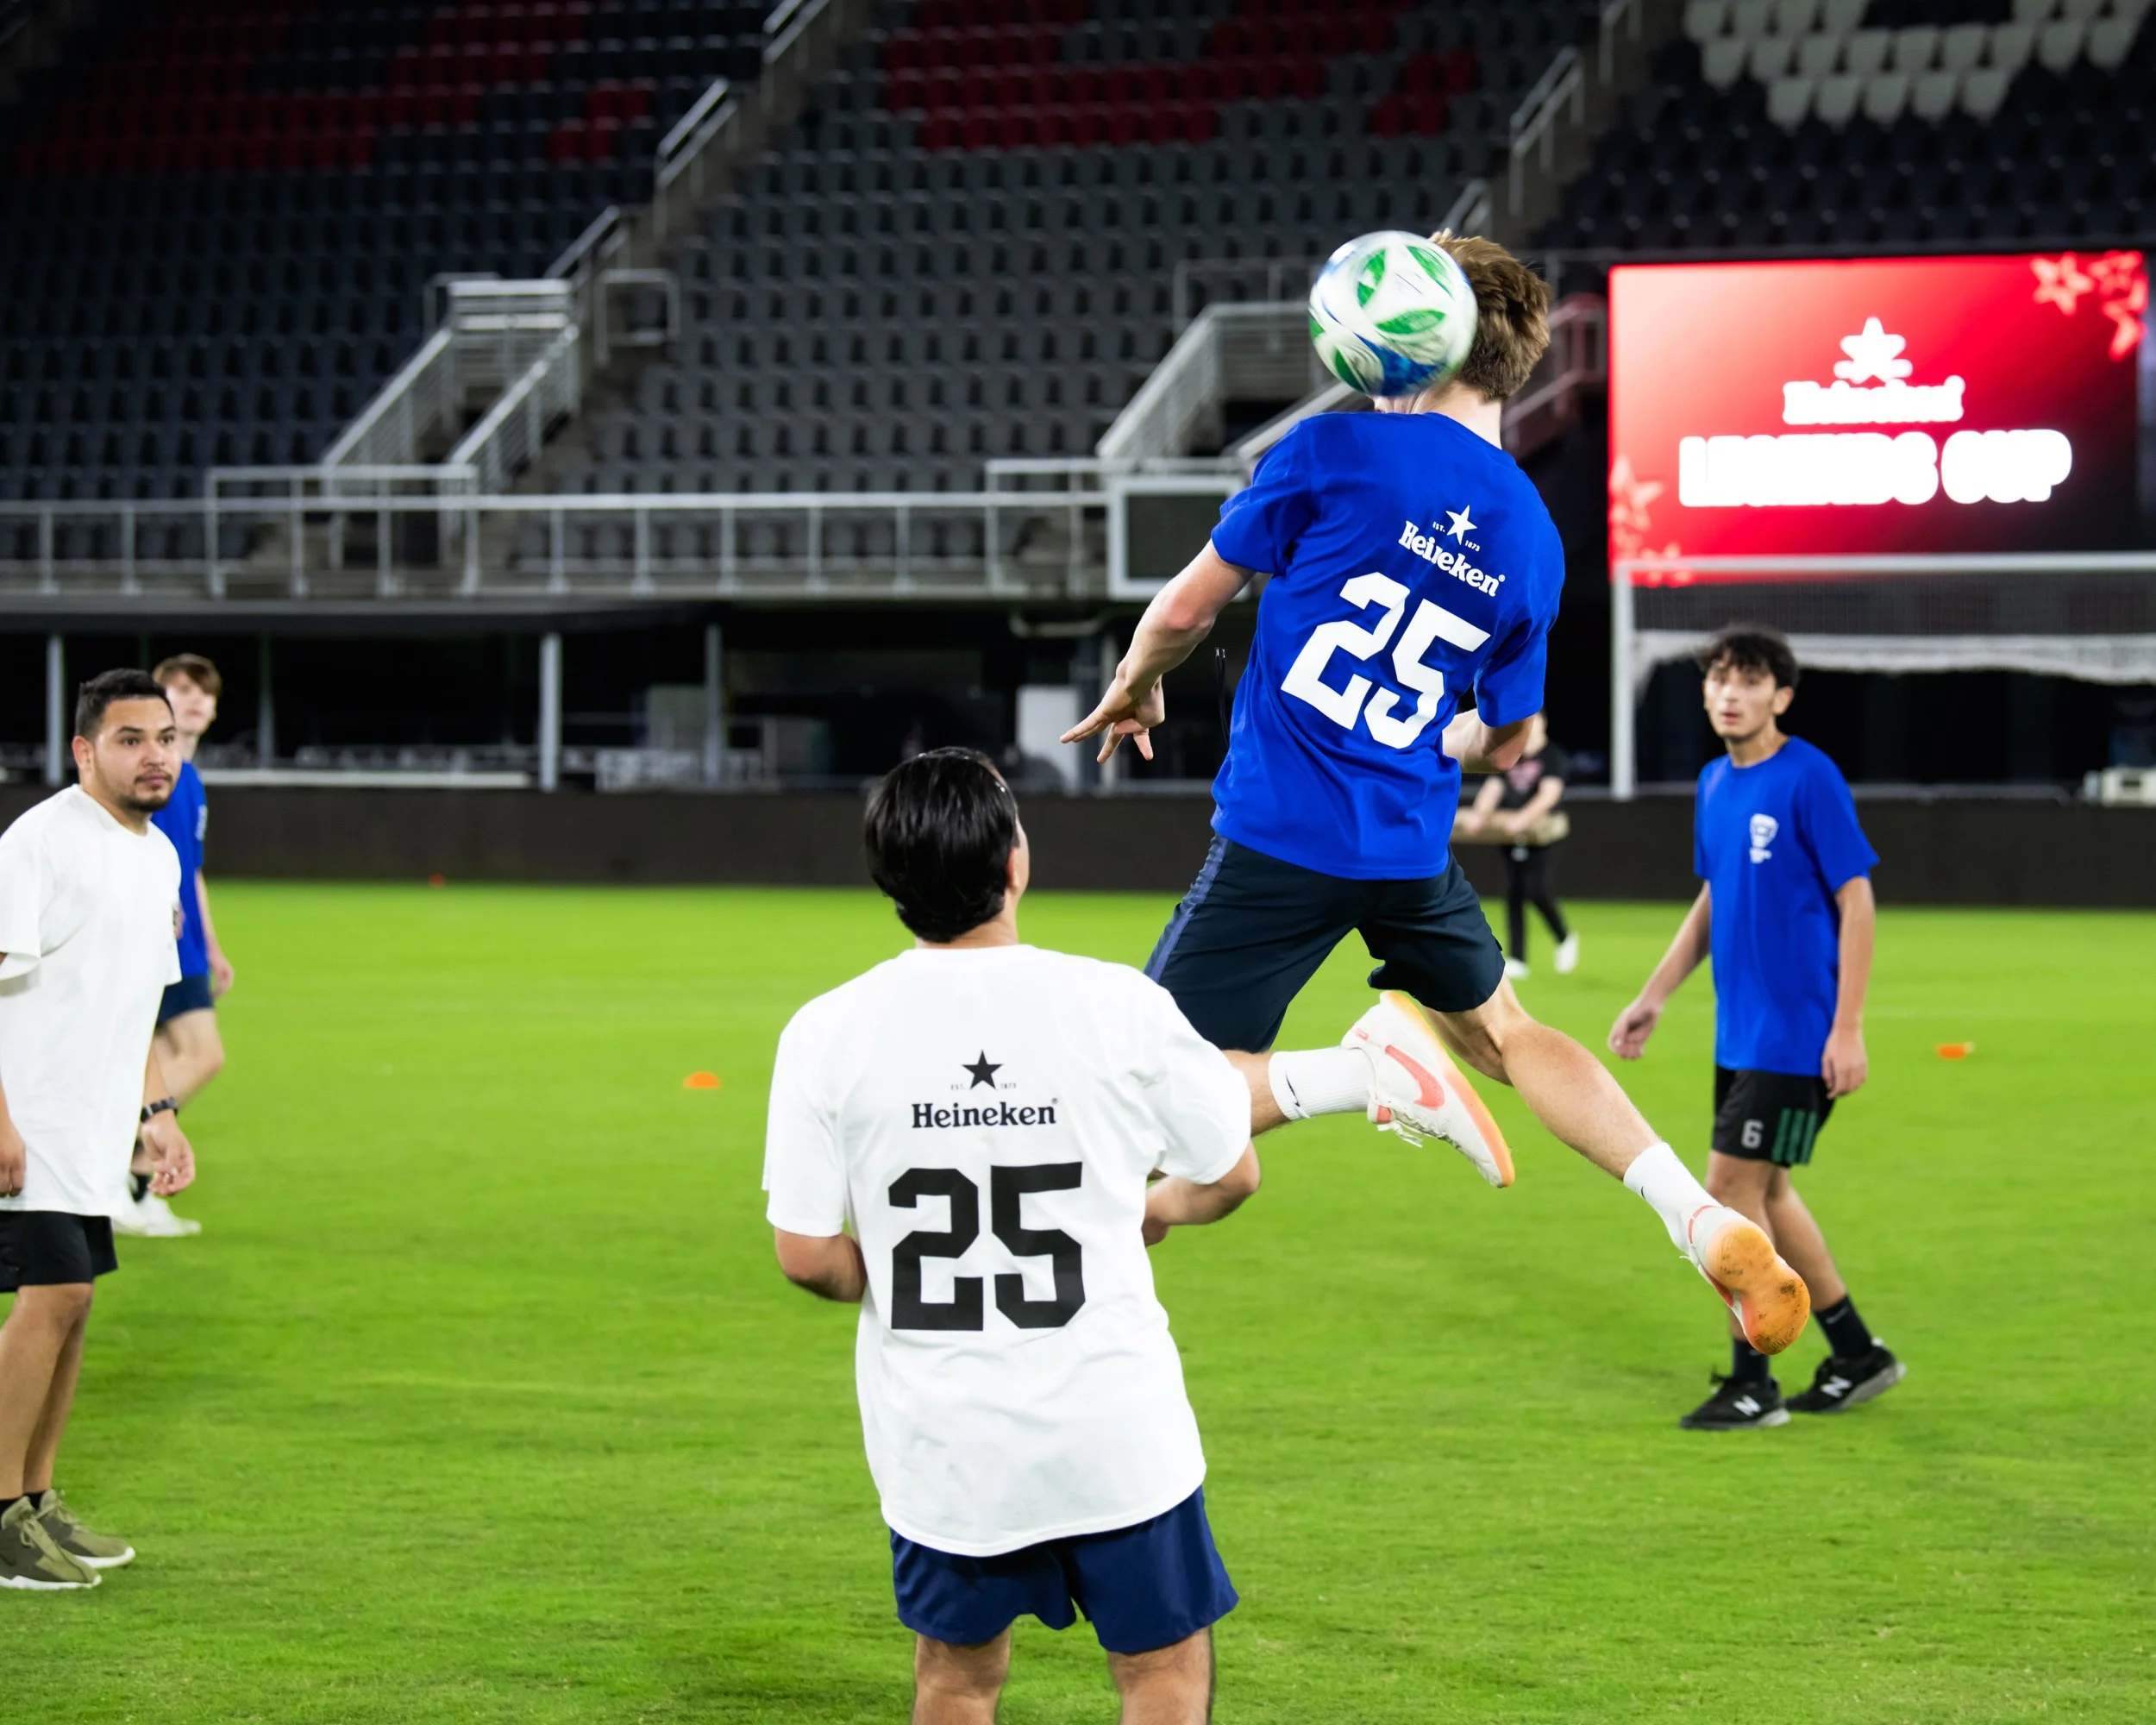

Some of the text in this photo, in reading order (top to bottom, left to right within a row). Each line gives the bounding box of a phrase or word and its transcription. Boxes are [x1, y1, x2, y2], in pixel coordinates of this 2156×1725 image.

[1281, 572, 1491, 749] 25
[1741, 1119, 1764, 1150] 6
[888, 1162, 1086, 1331] 25
